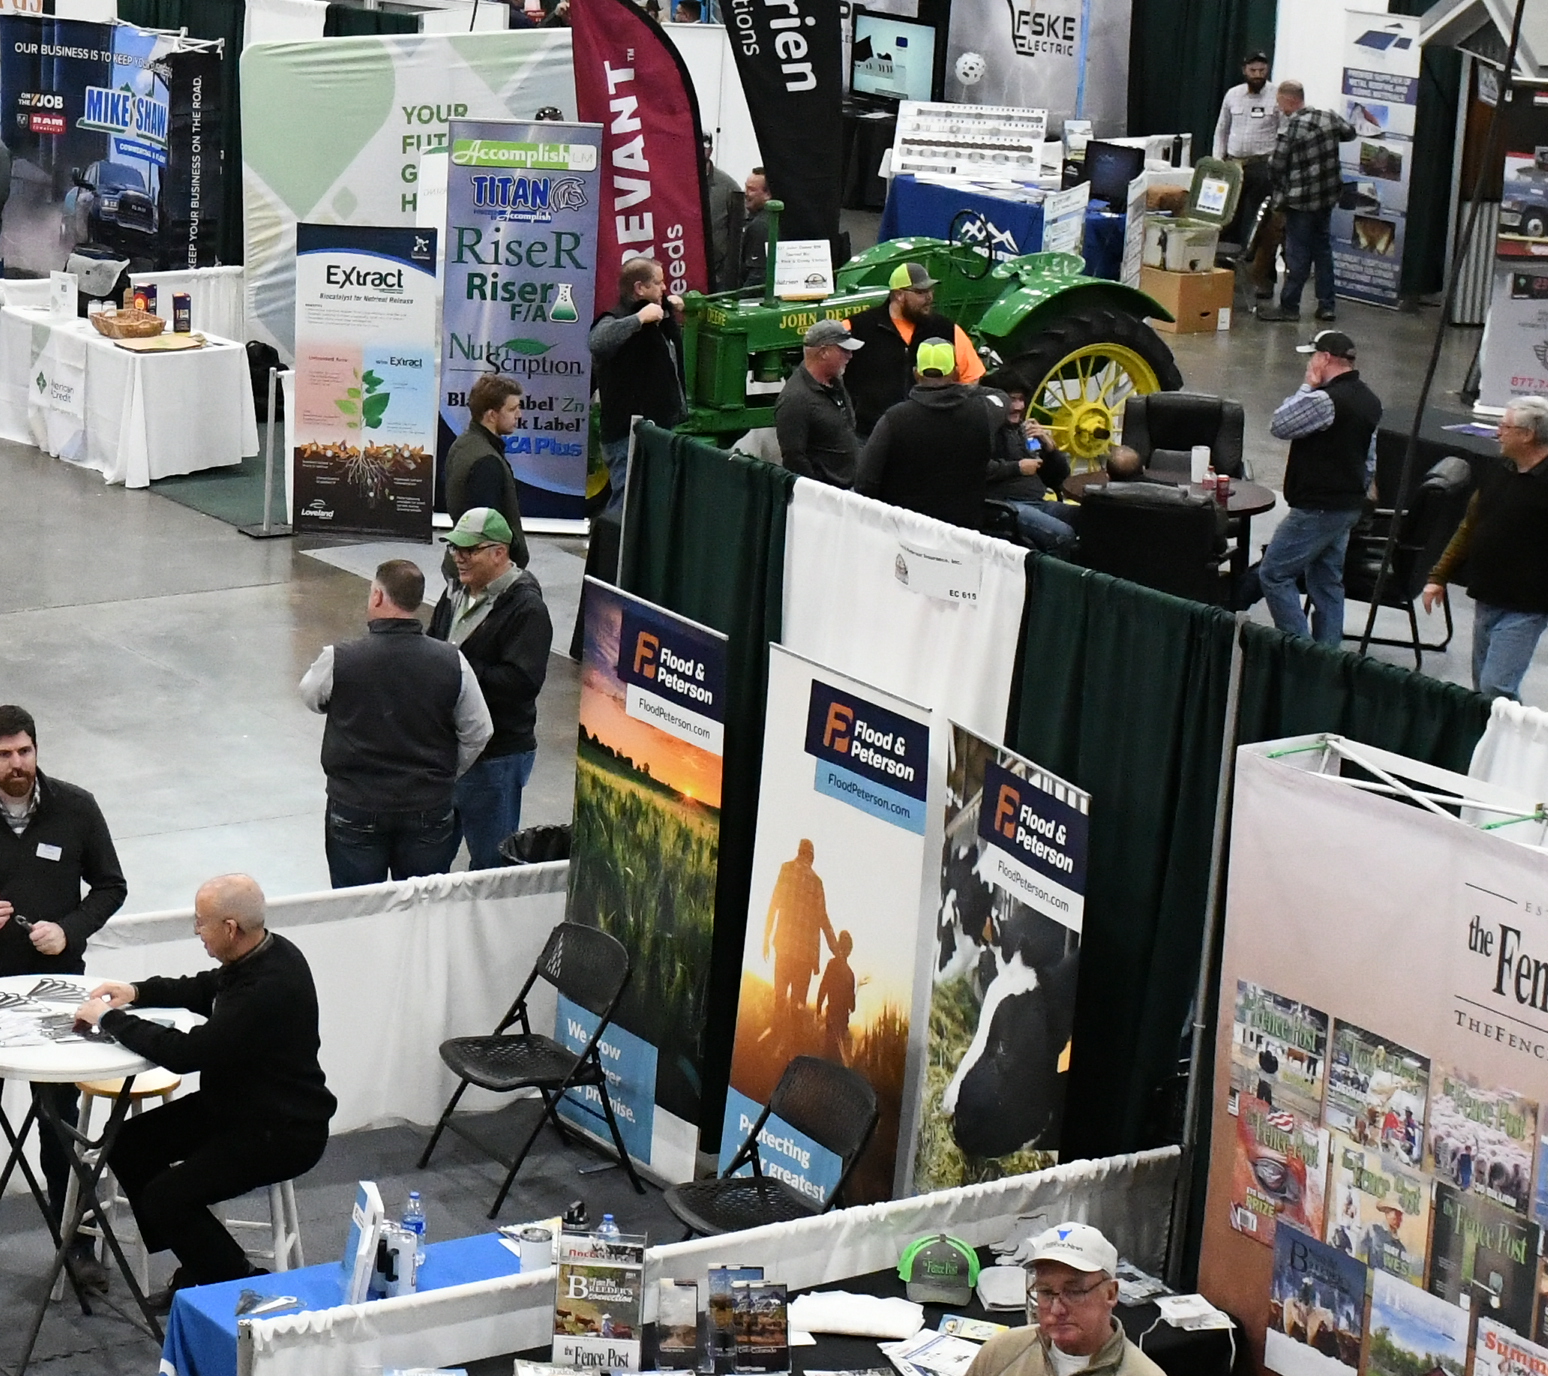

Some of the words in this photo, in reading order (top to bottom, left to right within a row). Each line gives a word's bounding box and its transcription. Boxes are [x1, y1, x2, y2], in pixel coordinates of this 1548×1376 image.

[15, 43, 38, 55] OUR
[40, 45, 89, 59] BUSINESS
[90, 50, 99, 60] IS
[100, 51, 112, 62] TO
[1016, 35, 1073, 57] ELECTRIC
[36, 95, 63, 109] JOB
[192, 74, 203, 109] ROAD.
[32, 116, 64, 126] RAM
[87, 88, 129, 126] MIKE
[136, 96, 167, 140] SHAW
[192, 111, 202, 134] THE
[191, 136, 201, 153] ON
[452, 140, 569, 165] Accomplish
[572, 151, 594, 164] LM
[189, 155, 200, 208] BUSINESS
[471, 176, 550, 208] TITAN
[188, 211, 199, 241] YOUR
[497, 211, 551, 223] Accomplish
[319, 293, 352, 303] Biocatalyst
[354, 295, 362, 304] for
[363, 295, 387, 304] Nutrient
[389, 296, 414, 304] Release
[467, 273, 551, 303] Riser
[510, 303, 546, 322] F/A
[780, 312, 817, 329] JOHN
[562, 396, 585, 413] Zn
[533, 416, 581, 432] Label
[530, 437, 582, 457] Plus
[301, 508, 334, 519] Loveland
[950, 588, 962, 599] EC
[659, 648, 692, 676] Flood
[695, 663, 705, 682] &
[658, 665, 713, 706] Peterson
[638, 697, 711, 740] FloodPeterson.com
[854, 719, 890, 750] Flood
[894, 736, 905, 756] &
[851, 741, 914, 782] Peterson
[828, 773, 911, 819] FloodPeterson.com
[1019, 804, 1052, 837] Flood
[1055, 826, 1066, 846] &
[1016, 826, 1073, 874] Peterson
[997, 860, 1070, 913] FloodPeterson.com
[1468, 915, 1494, 957] the
[567, 1018, 587, 1044] We
[769, 1165, 825, 1203] greatest
[564, 1346, 573, 1356] the
[574, 1346, 605, 1366] Fence
[607, 1348, 629, 1369] Post
